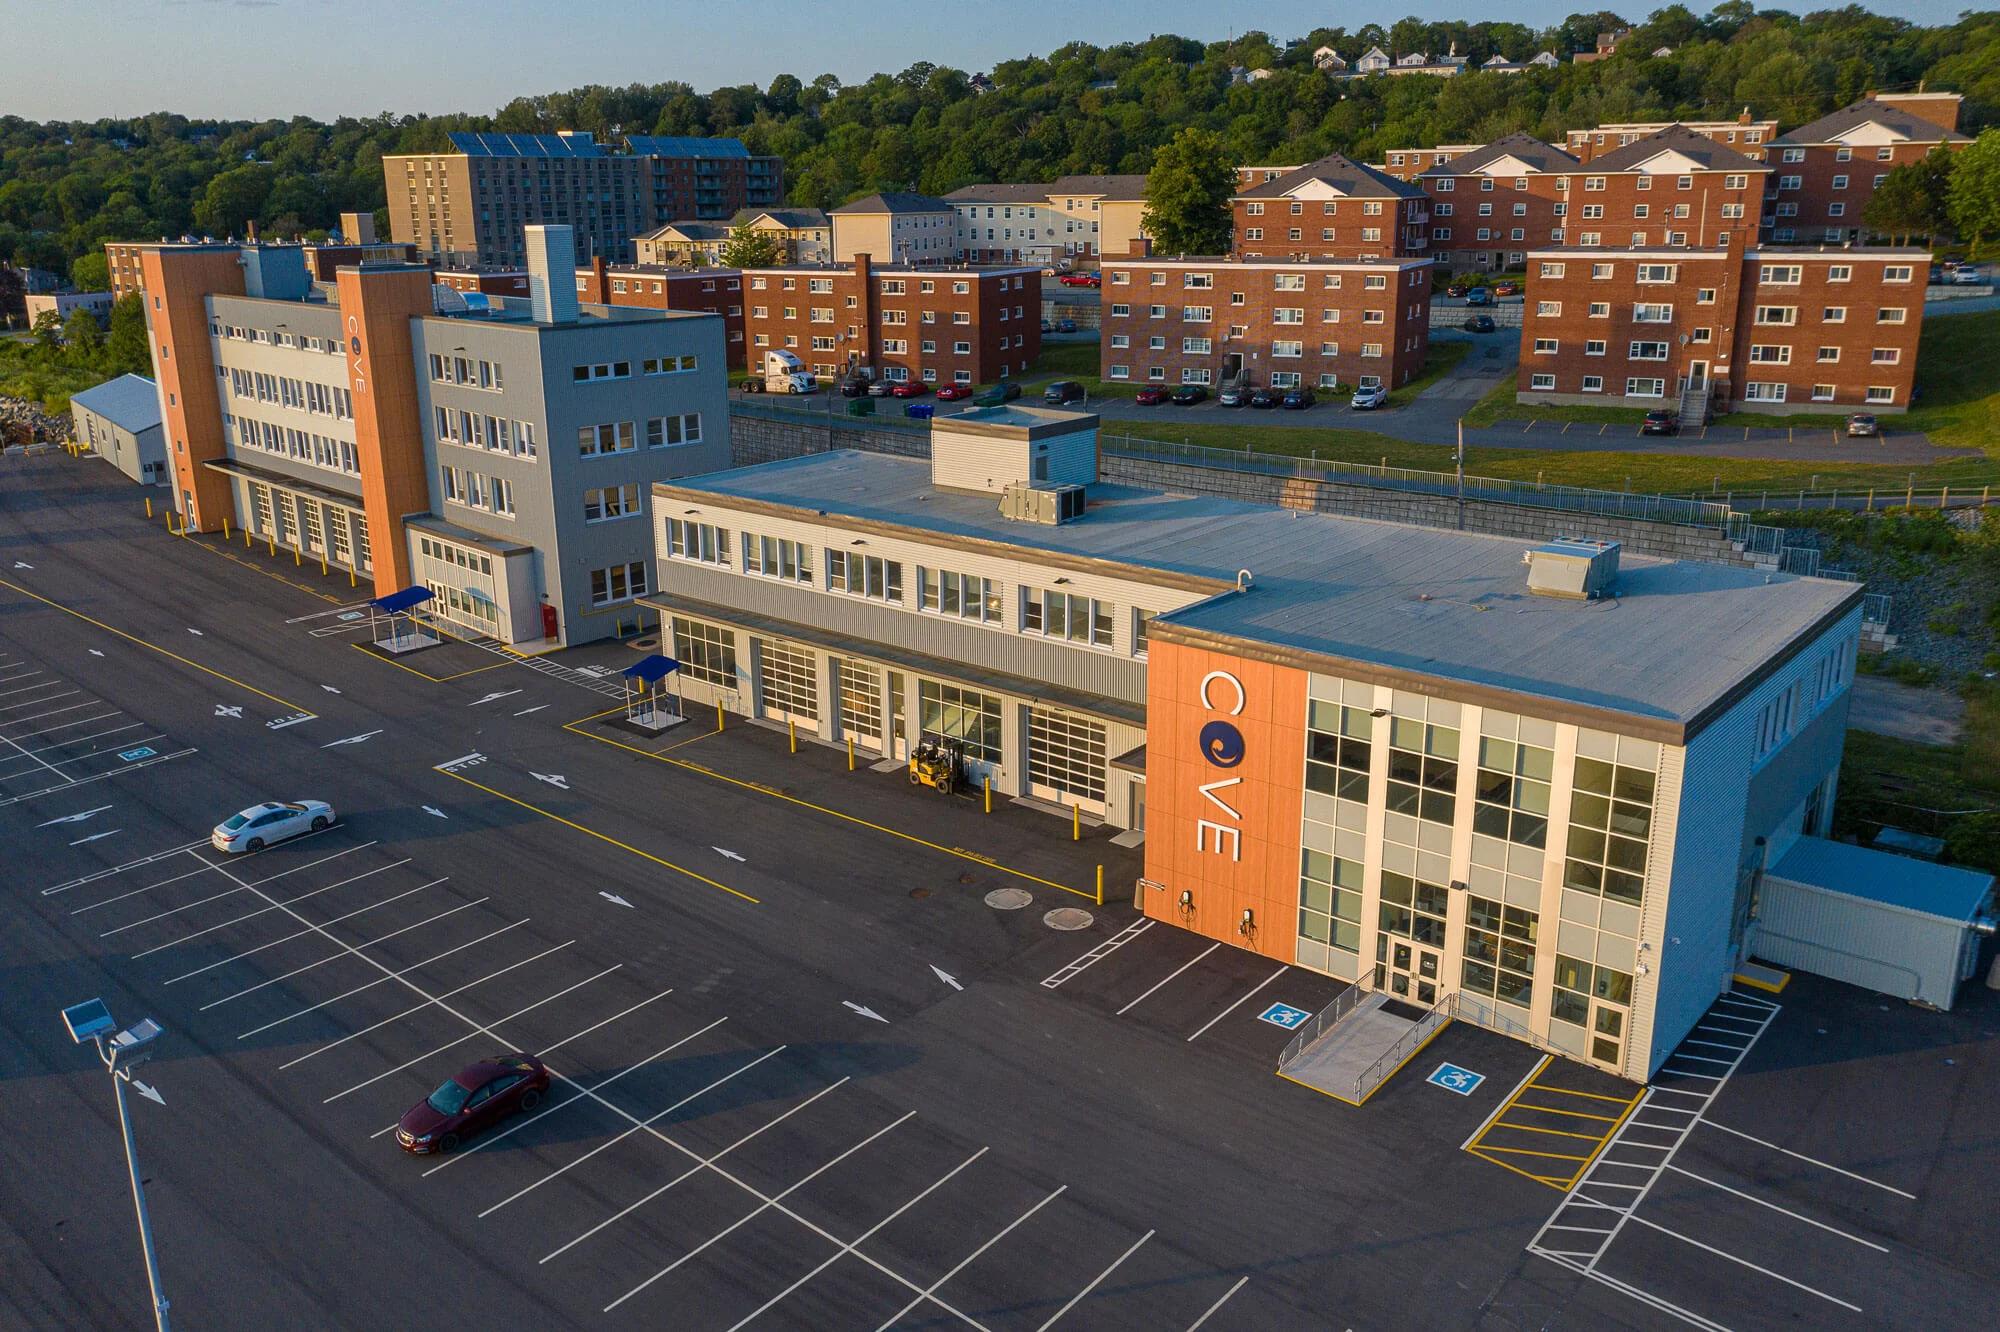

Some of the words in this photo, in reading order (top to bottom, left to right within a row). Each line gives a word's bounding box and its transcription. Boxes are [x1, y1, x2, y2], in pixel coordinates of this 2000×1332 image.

[348, 315, 366, 393] COVE
[265, 712, 307, 727] STOP
[446, 756, 488, 772] STOP
[1197, 670, 1244, 862] COVE
